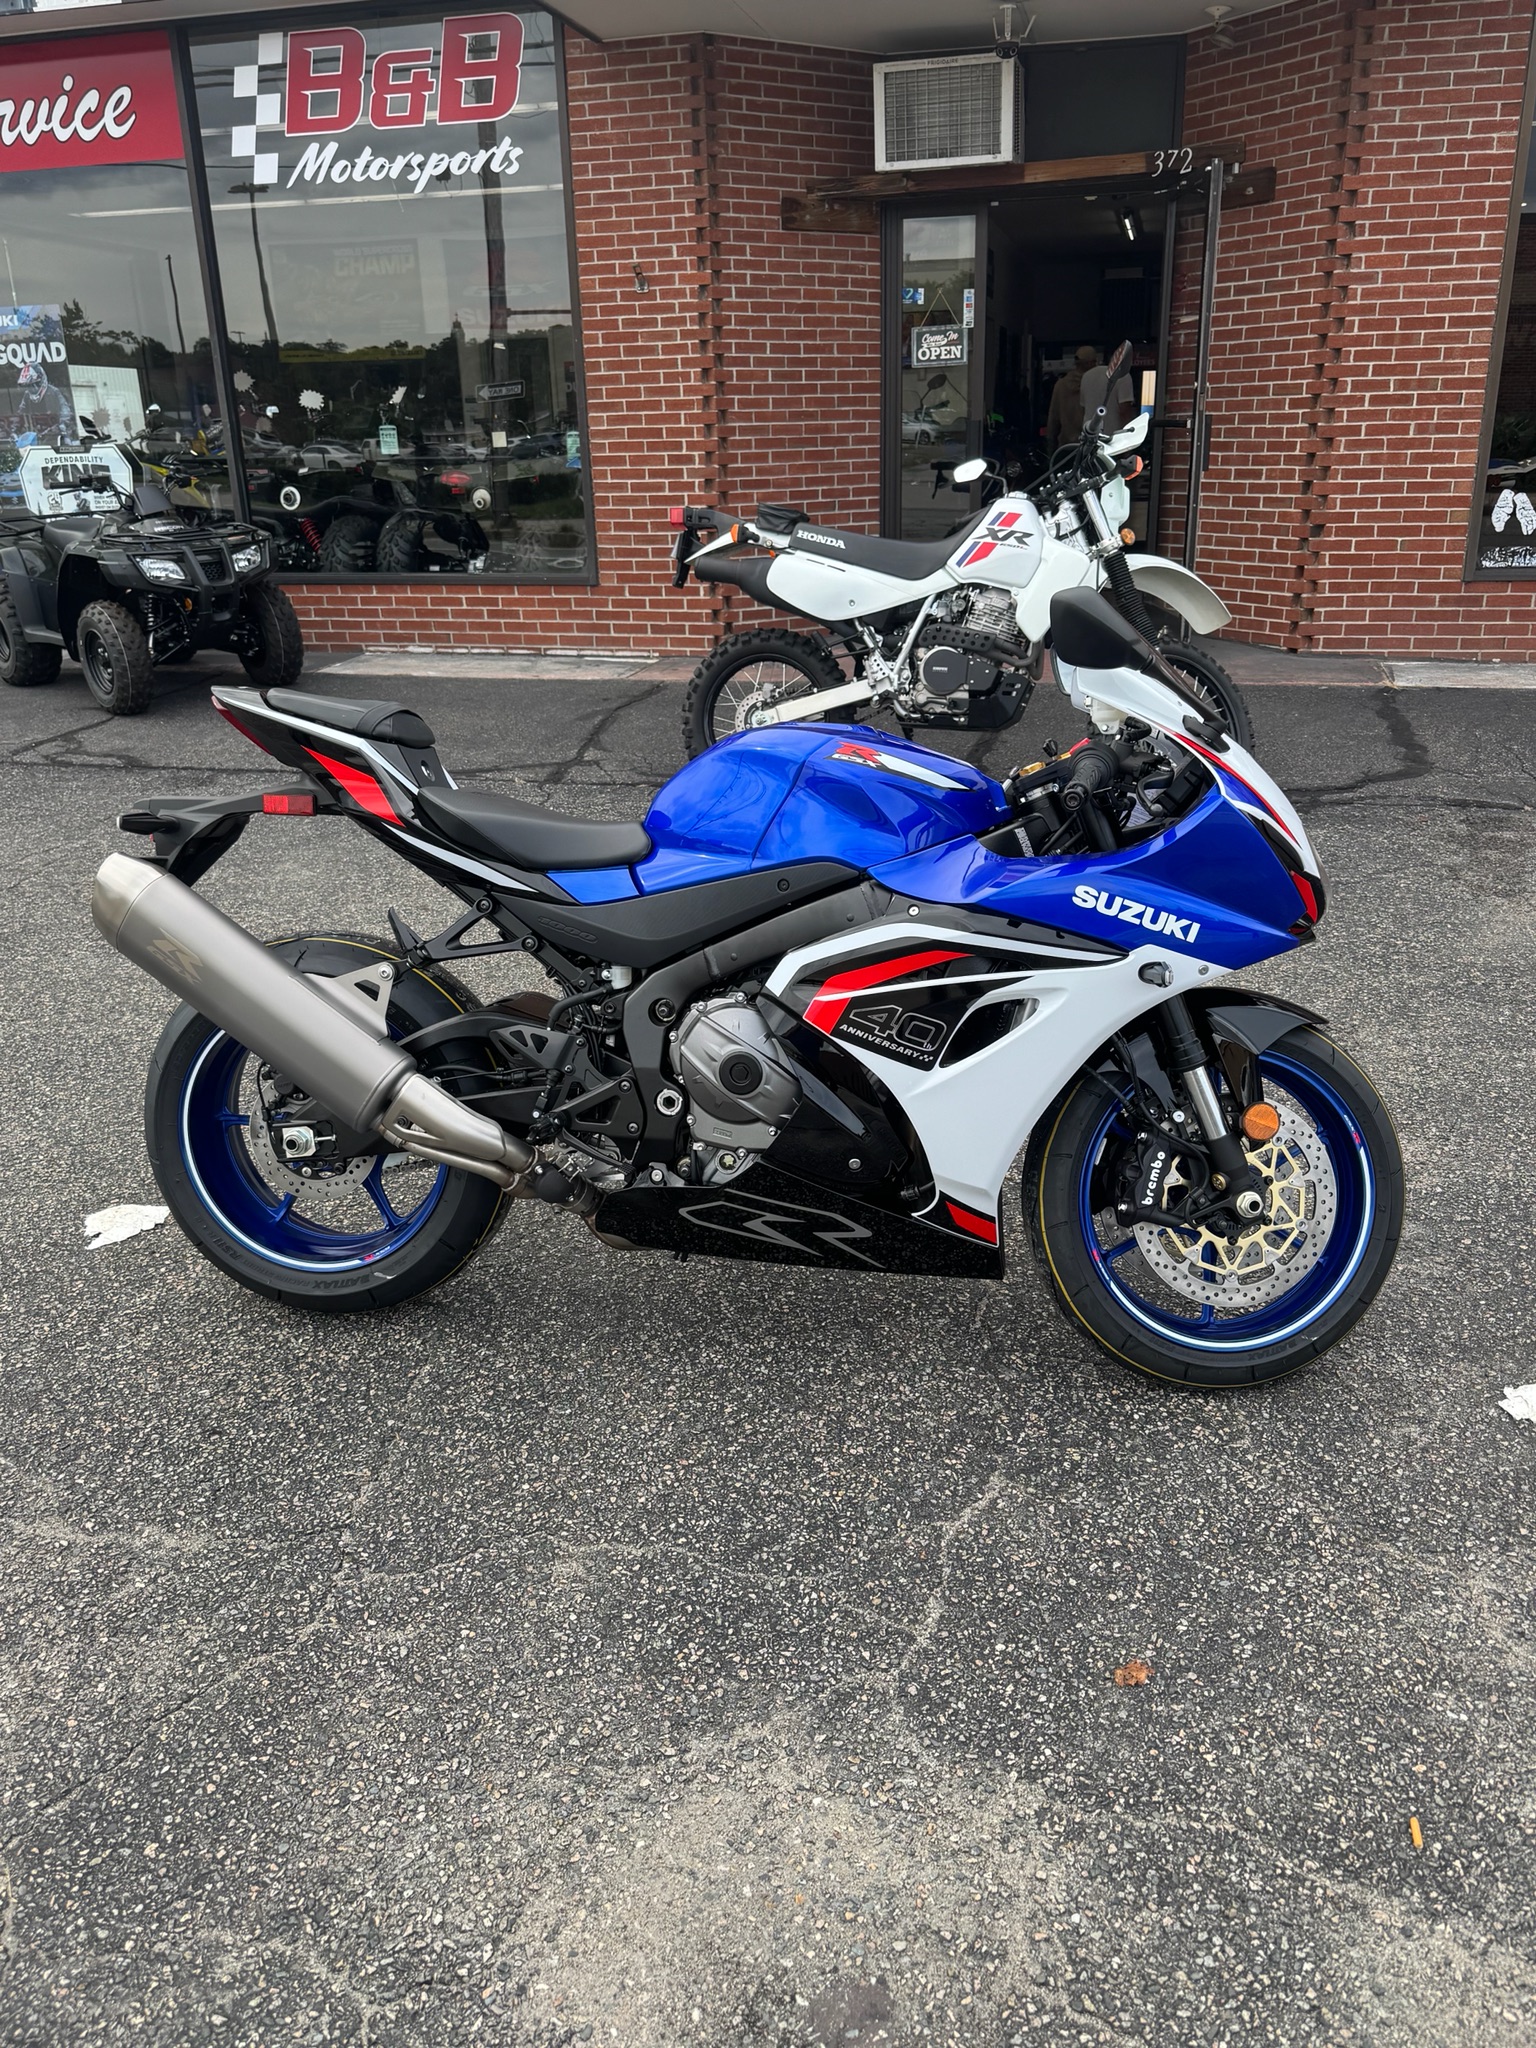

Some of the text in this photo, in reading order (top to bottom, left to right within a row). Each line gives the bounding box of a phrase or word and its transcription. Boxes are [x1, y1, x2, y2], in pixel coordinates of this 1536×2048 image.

[927, 57, 959, 66] FRIGIDAIRE
[285, 12, 525, 138] B&B
[287, 136, 524, 194] Motorsports
[1151, 147, 1193, 178] 372
[334, 253, 416, 277] CHAMP
[921, 330, 959, 344] Come In
[917, 345, 963, 361] OPEN
[44, 455, 104, 465] DEPENDABILITY
[796, 529, 846, 549] HONDA
[969, 526, 1034, 547] XR
[1072, 885, 1201, 943] SUZUKI
[839, 1024, 921, 1058] ANNIVERSARY
[1141, 1151, 1166, 1205] brembo
